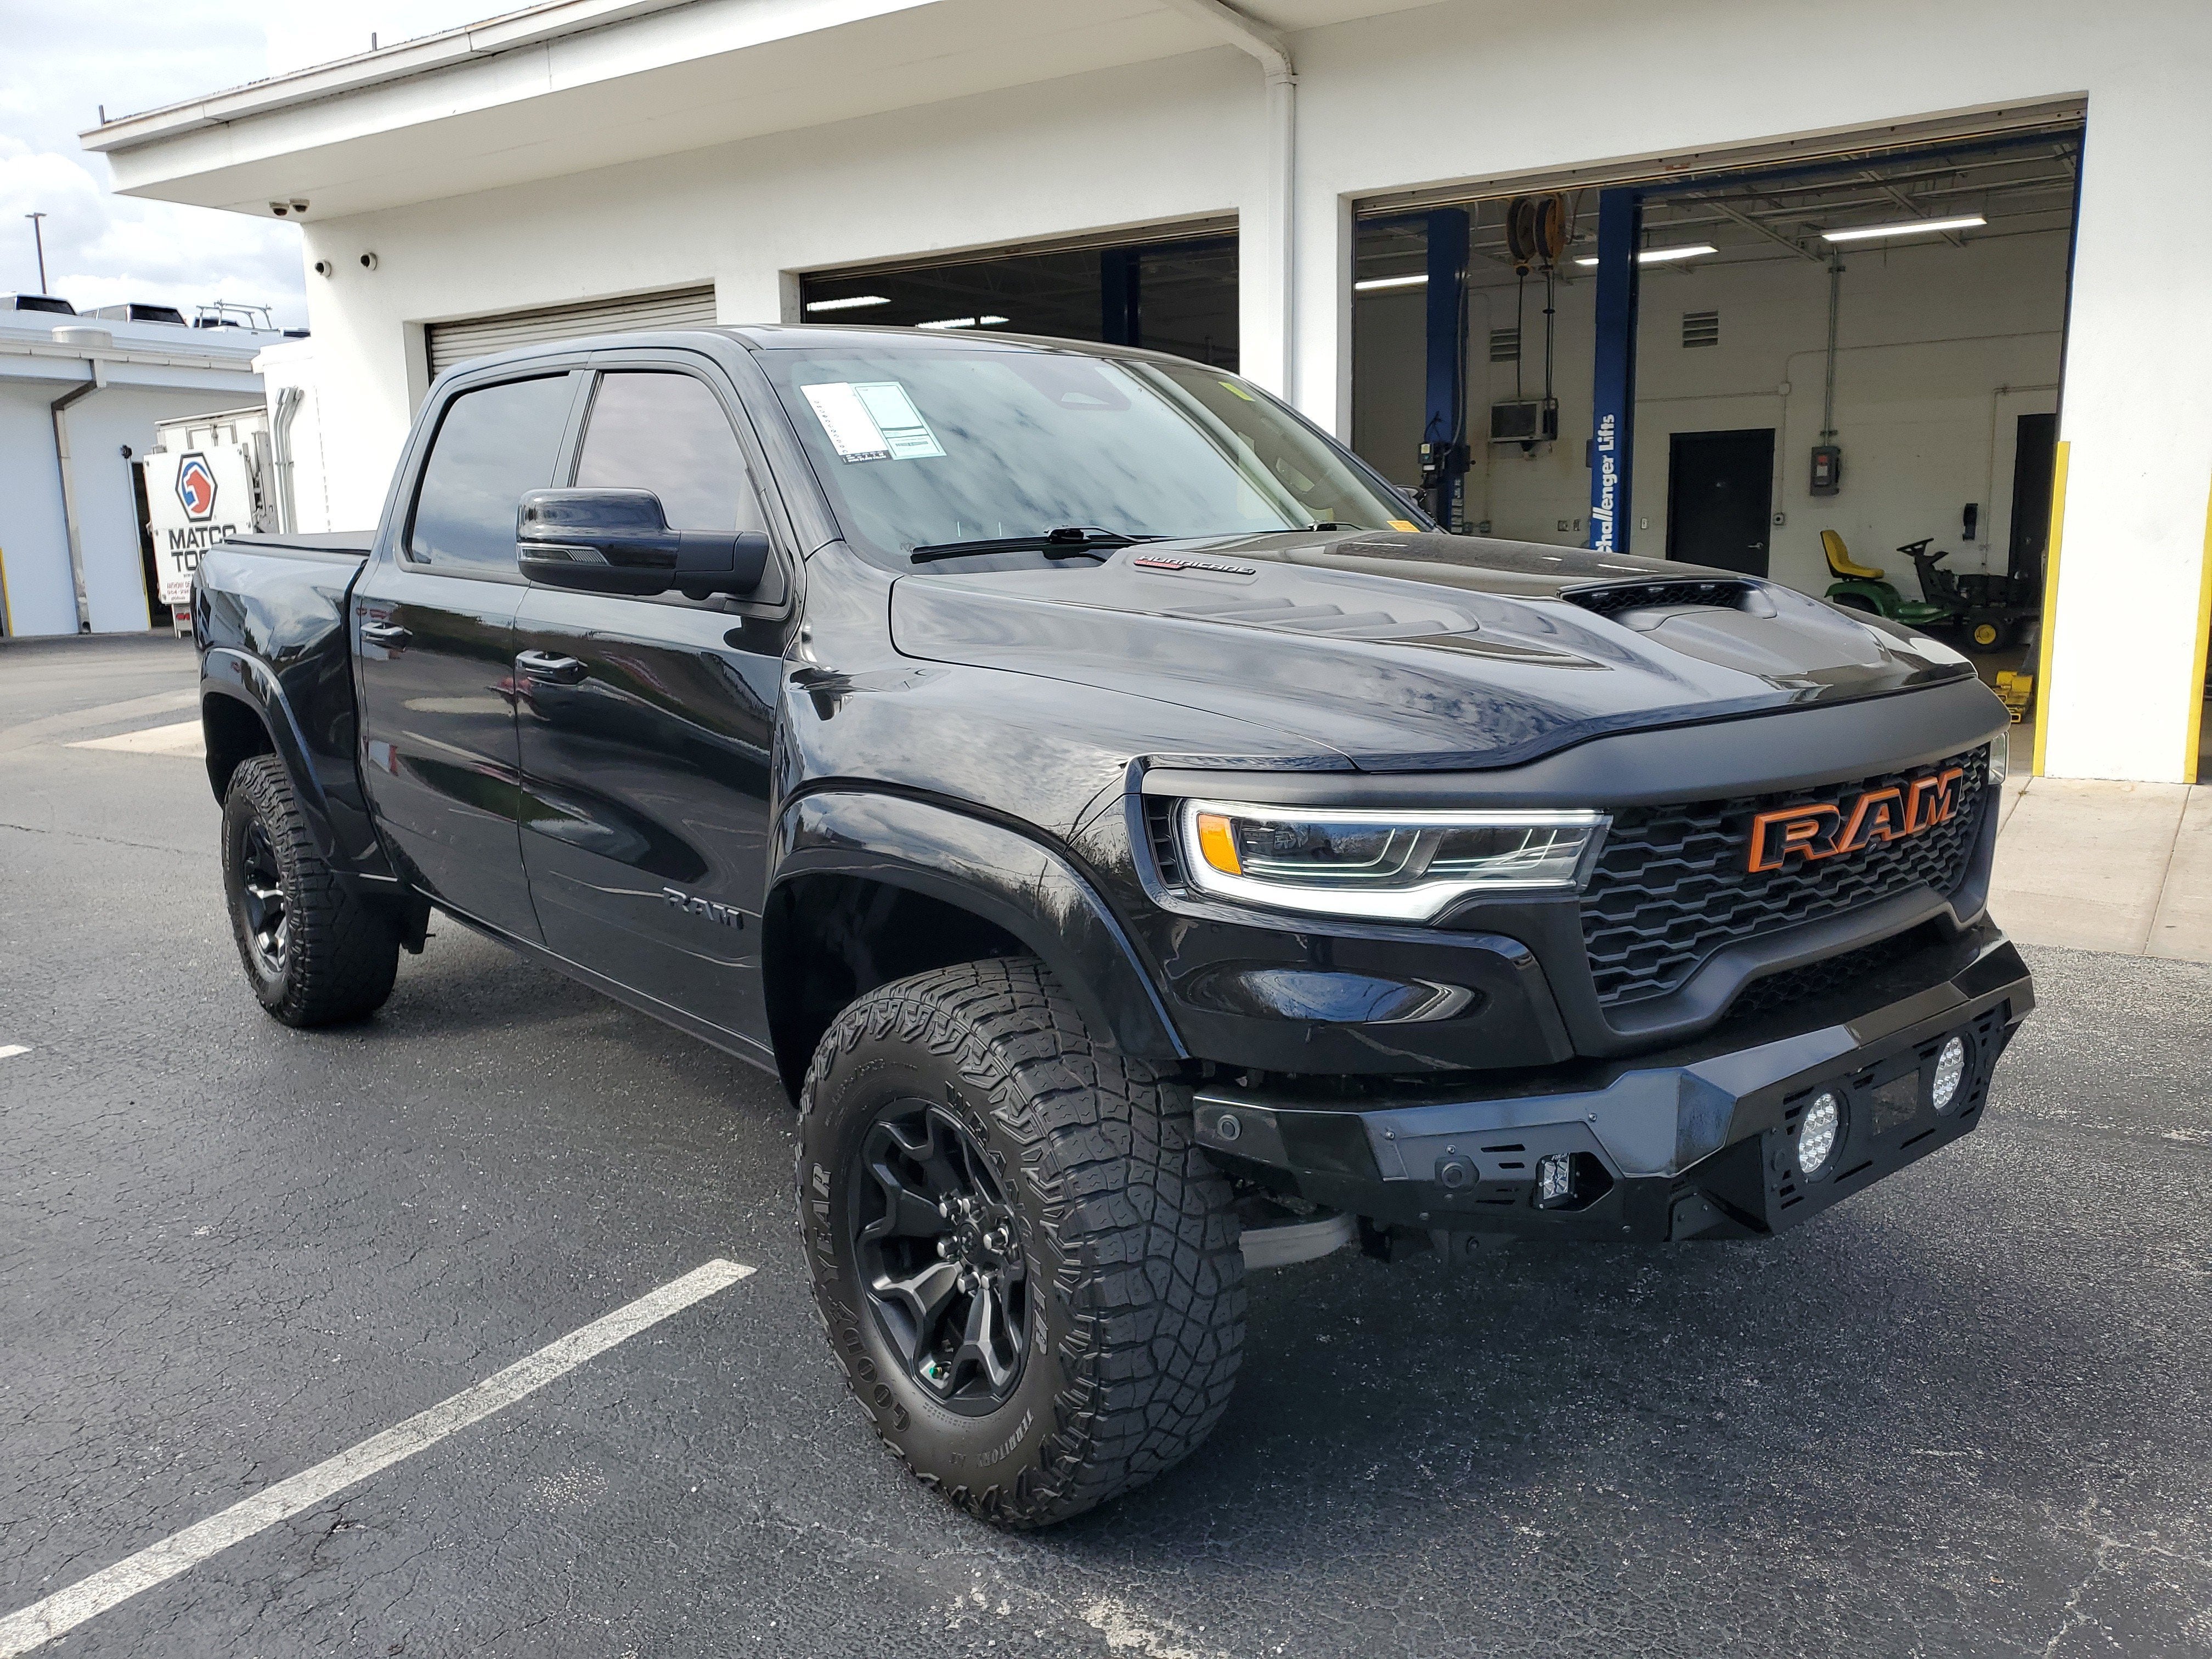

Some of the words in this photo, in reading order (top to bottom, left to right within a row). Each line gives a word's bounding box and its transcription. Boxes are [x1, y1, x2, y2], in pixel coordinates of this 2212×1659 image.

[1597, 414, 1615, 451] Lifts
[168, 523, 236, 550] MATCO
[1138, 555, 1254, 574] HURRICANE
[1748, 768, 1963, 872] RAM
[663, 886, 744, 929] RAM
